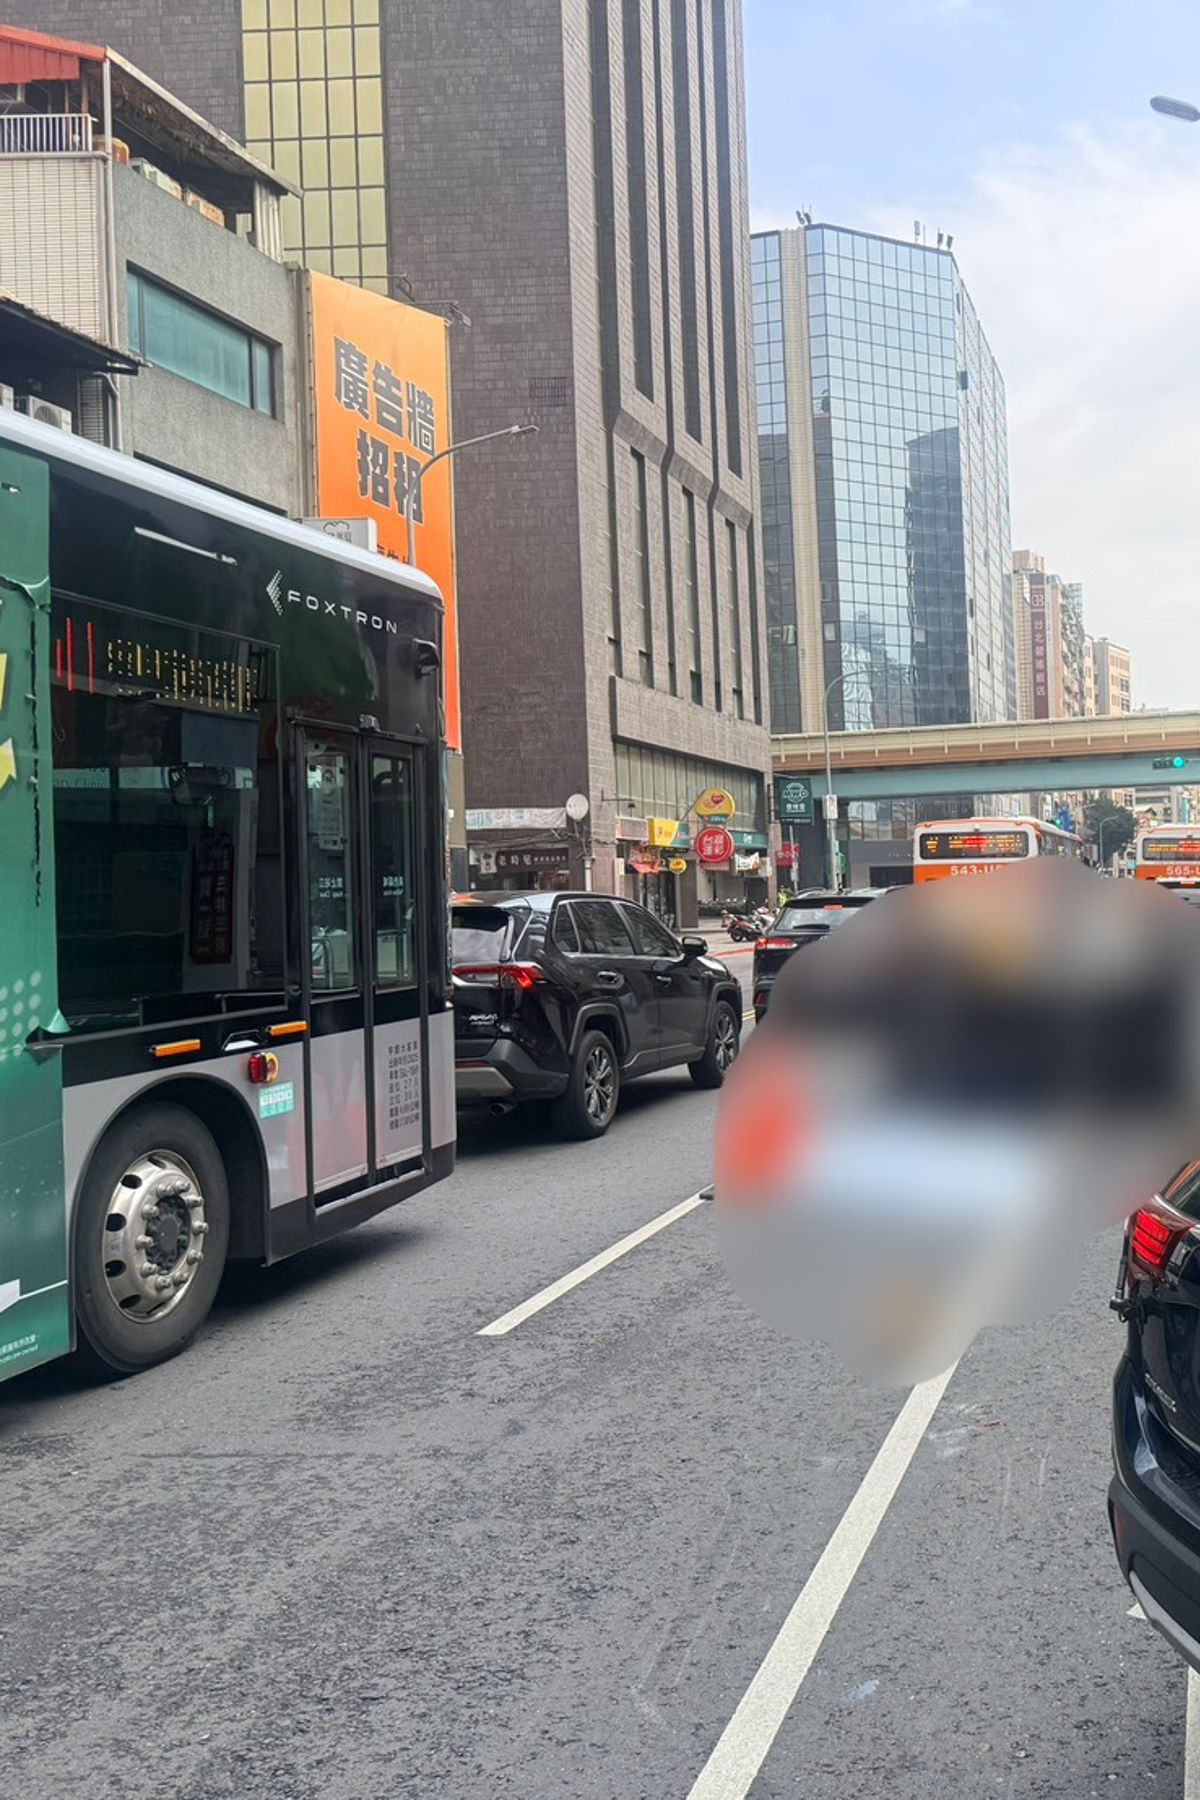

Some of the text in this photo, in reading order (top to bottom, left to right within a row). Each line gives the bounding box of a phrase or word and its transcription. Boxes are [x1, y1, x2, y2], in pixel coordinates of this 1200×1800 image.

[334, 335, 435, 457] 廣告牆
[357, 428, 424, 524] 招租
[287, 589, 398, 634] FOXTRON
